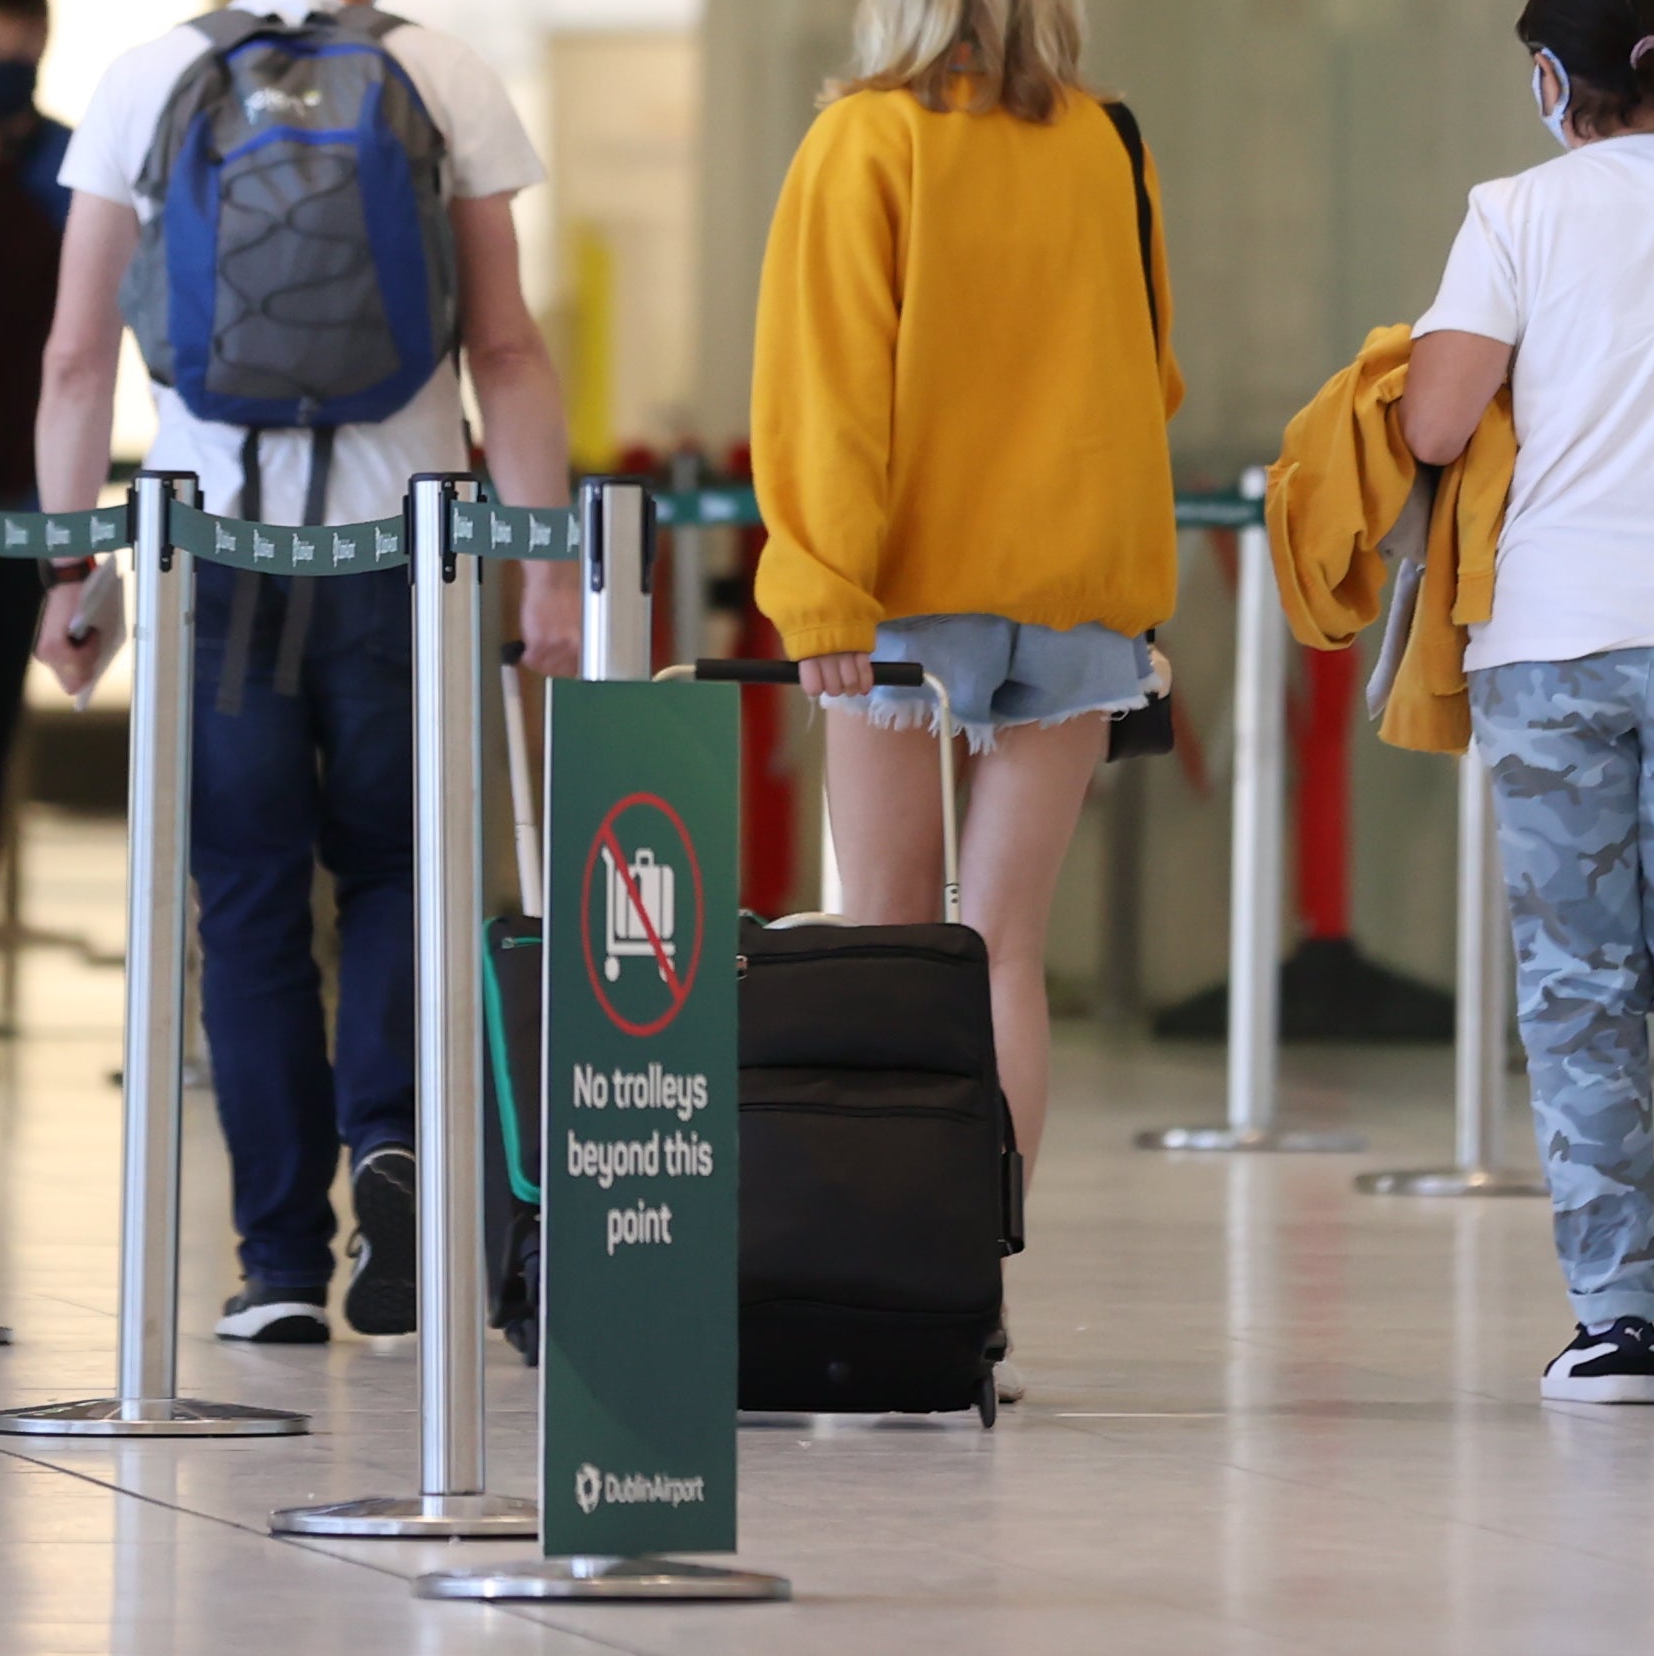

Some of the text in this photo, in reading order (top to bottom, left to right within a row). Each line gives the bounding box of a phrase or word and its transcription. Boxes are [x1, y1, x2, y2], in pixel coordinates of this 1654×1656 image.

[573, 1063, 708, 1122] No trolleys
[568, 1130, 713, 1189] beyond this
[607, 1200, 672, 1256] point
